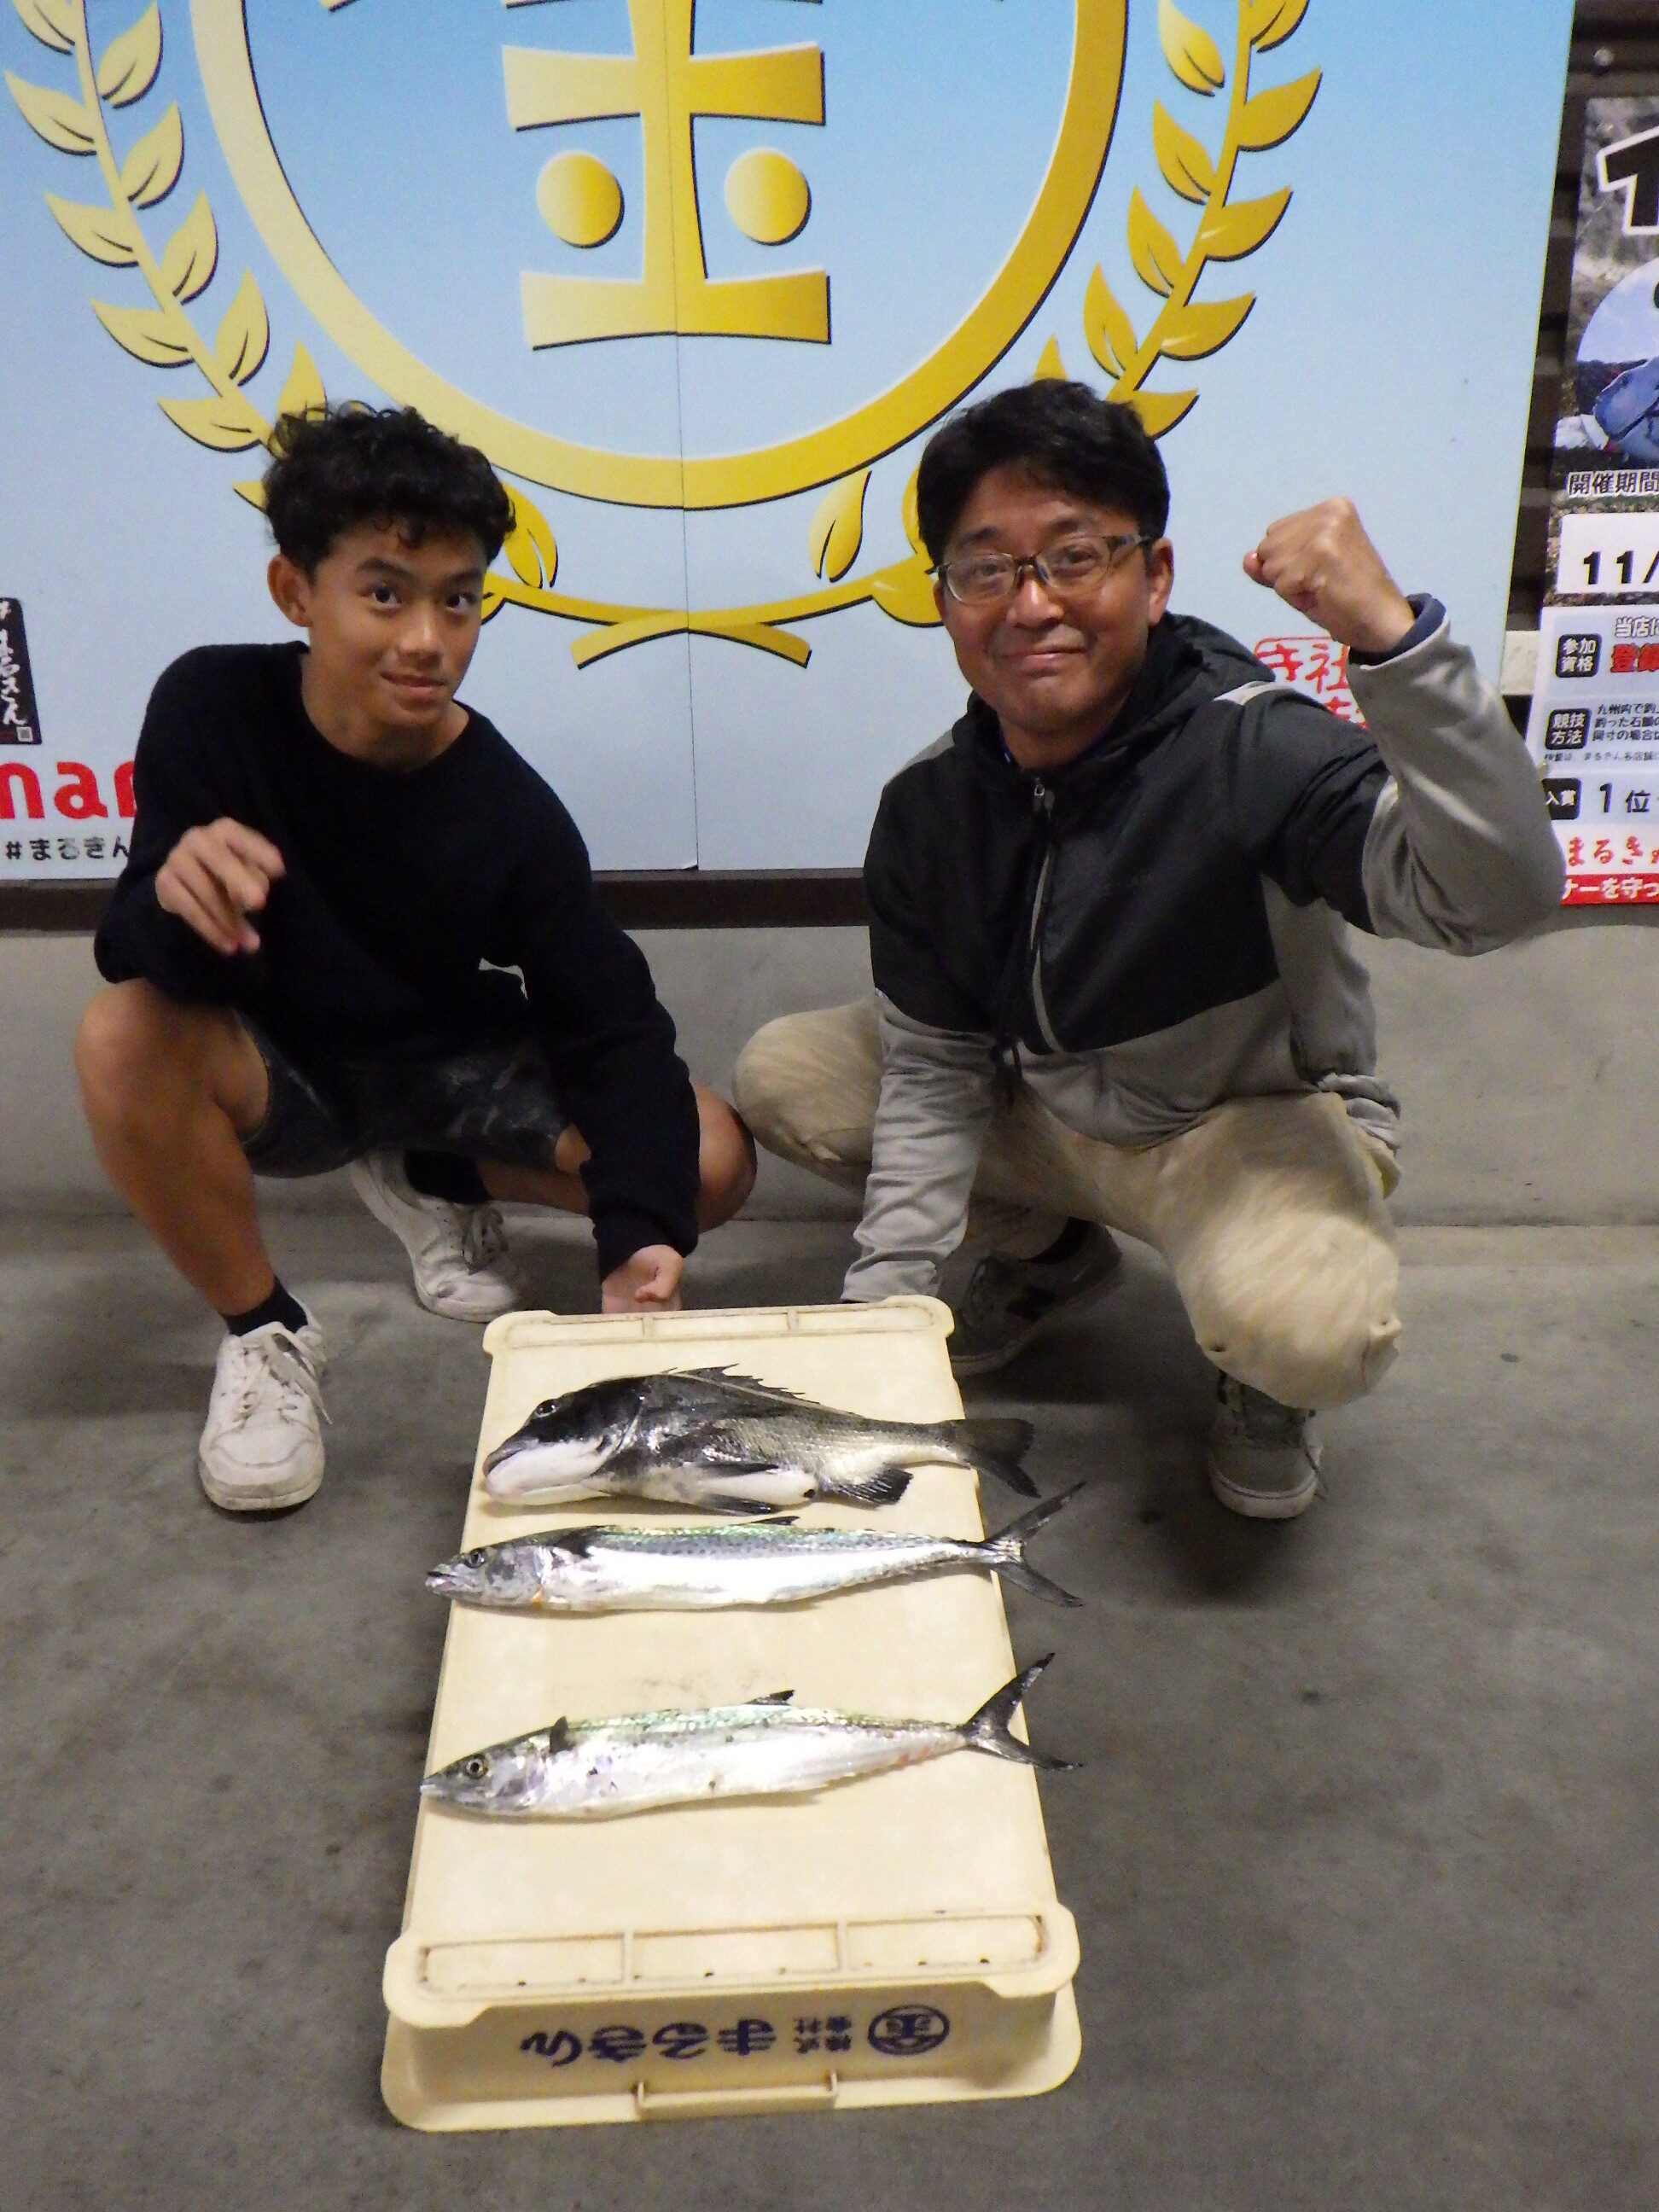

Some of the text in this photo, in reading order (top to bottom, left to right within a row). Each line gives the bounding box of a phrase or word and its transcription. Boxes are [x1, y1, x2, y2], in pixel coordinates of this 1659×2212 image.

[1569, 471, 1659, 495] 開催期間
[1562, 637, 1597, 655] 参加
[1560, 655, 1594, 673] 資格
[1551, 729, 1582, 745] 方法
[520, 2017, 777, 2068] まるきん
